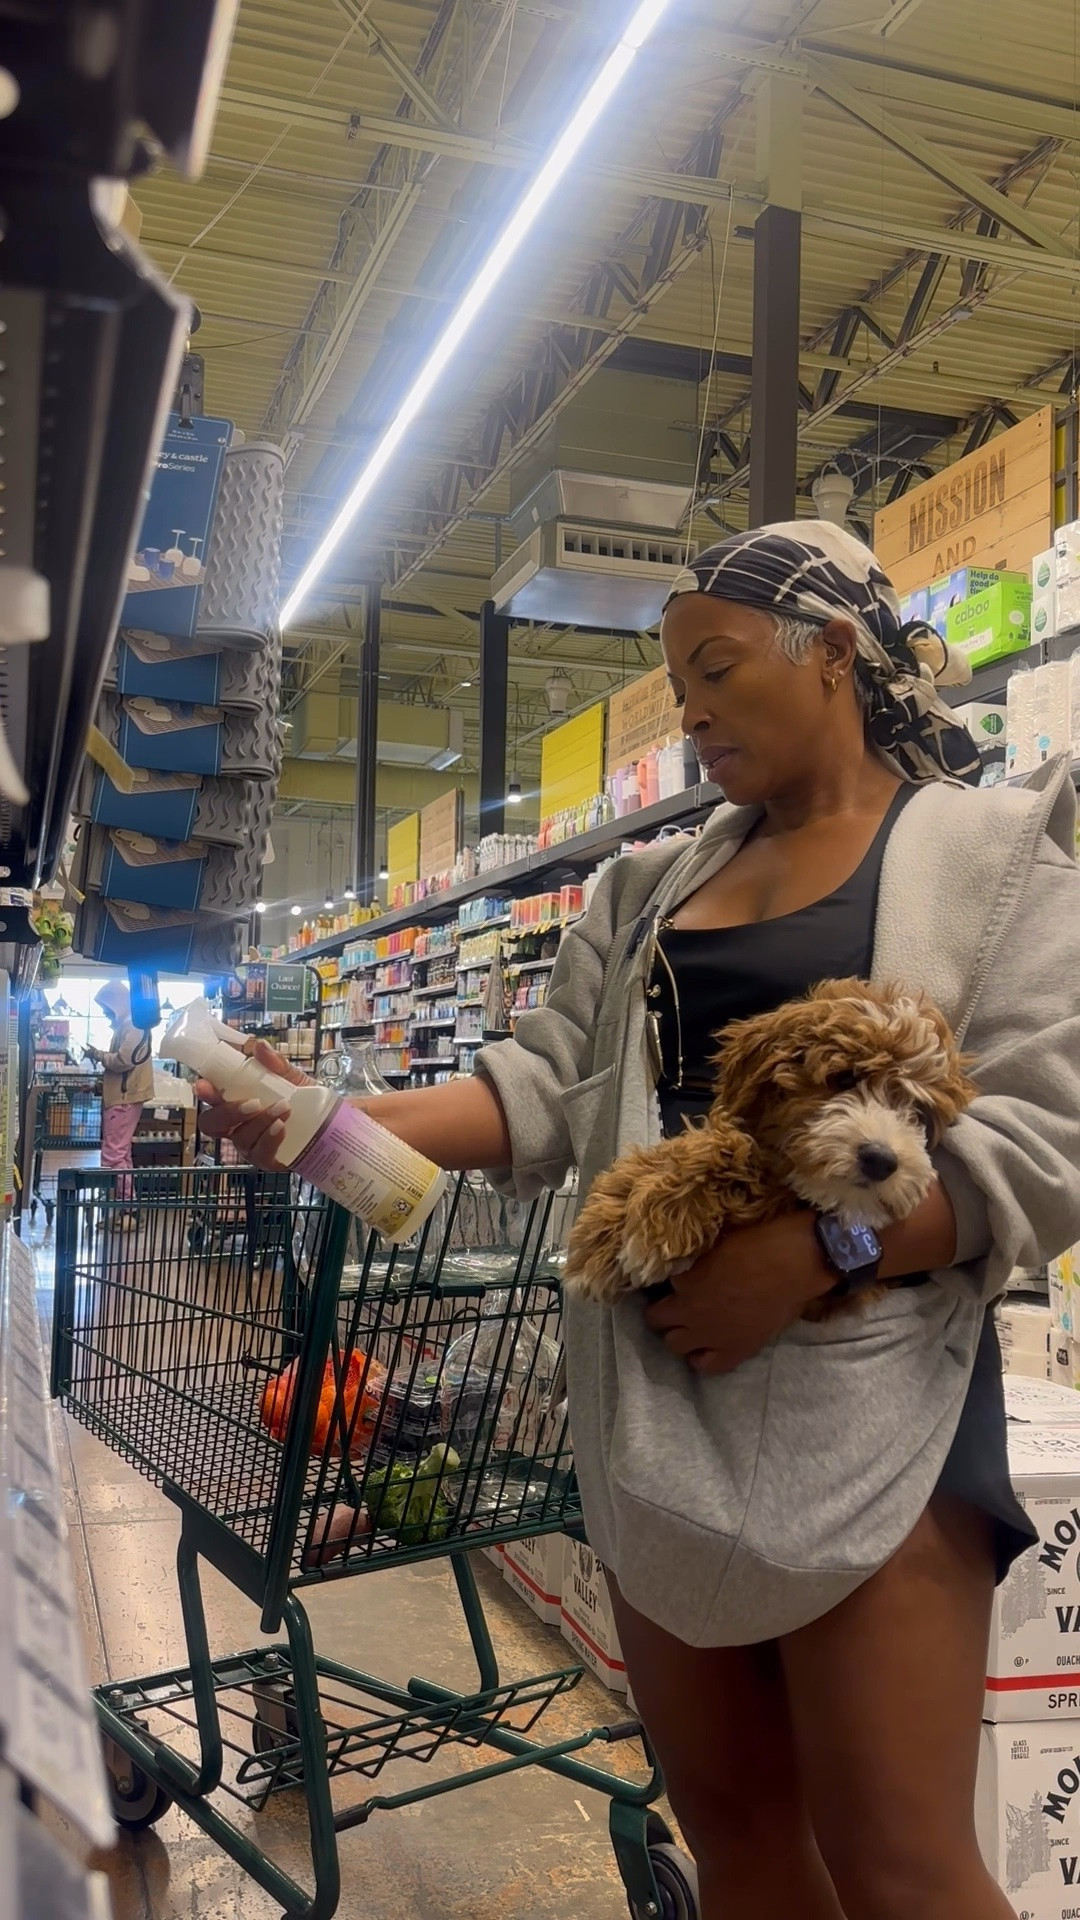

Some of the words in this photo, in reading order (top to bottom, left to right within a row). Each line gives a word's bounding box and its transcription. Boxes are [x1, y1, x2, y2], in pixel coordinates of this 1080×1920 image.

[178, 453, 209, 463] castle
[908, 448, 1006, 553] MISSION
[932, 535, 977, 578] AND
[970, 570, 988, 581] Help
[989, 572, 1000, 581] do
[970, 580, 989, 588] good
[955, 599, 990, 626] caboo
[278, 975, 294, 983] Last
[271, 982, 301, 991] Chance!
[573, 1573, 598, 1613] VALLEY
[1050, 1838, 1070, 1847] SINCE
[1059, 1856, 1080, 1886] V
